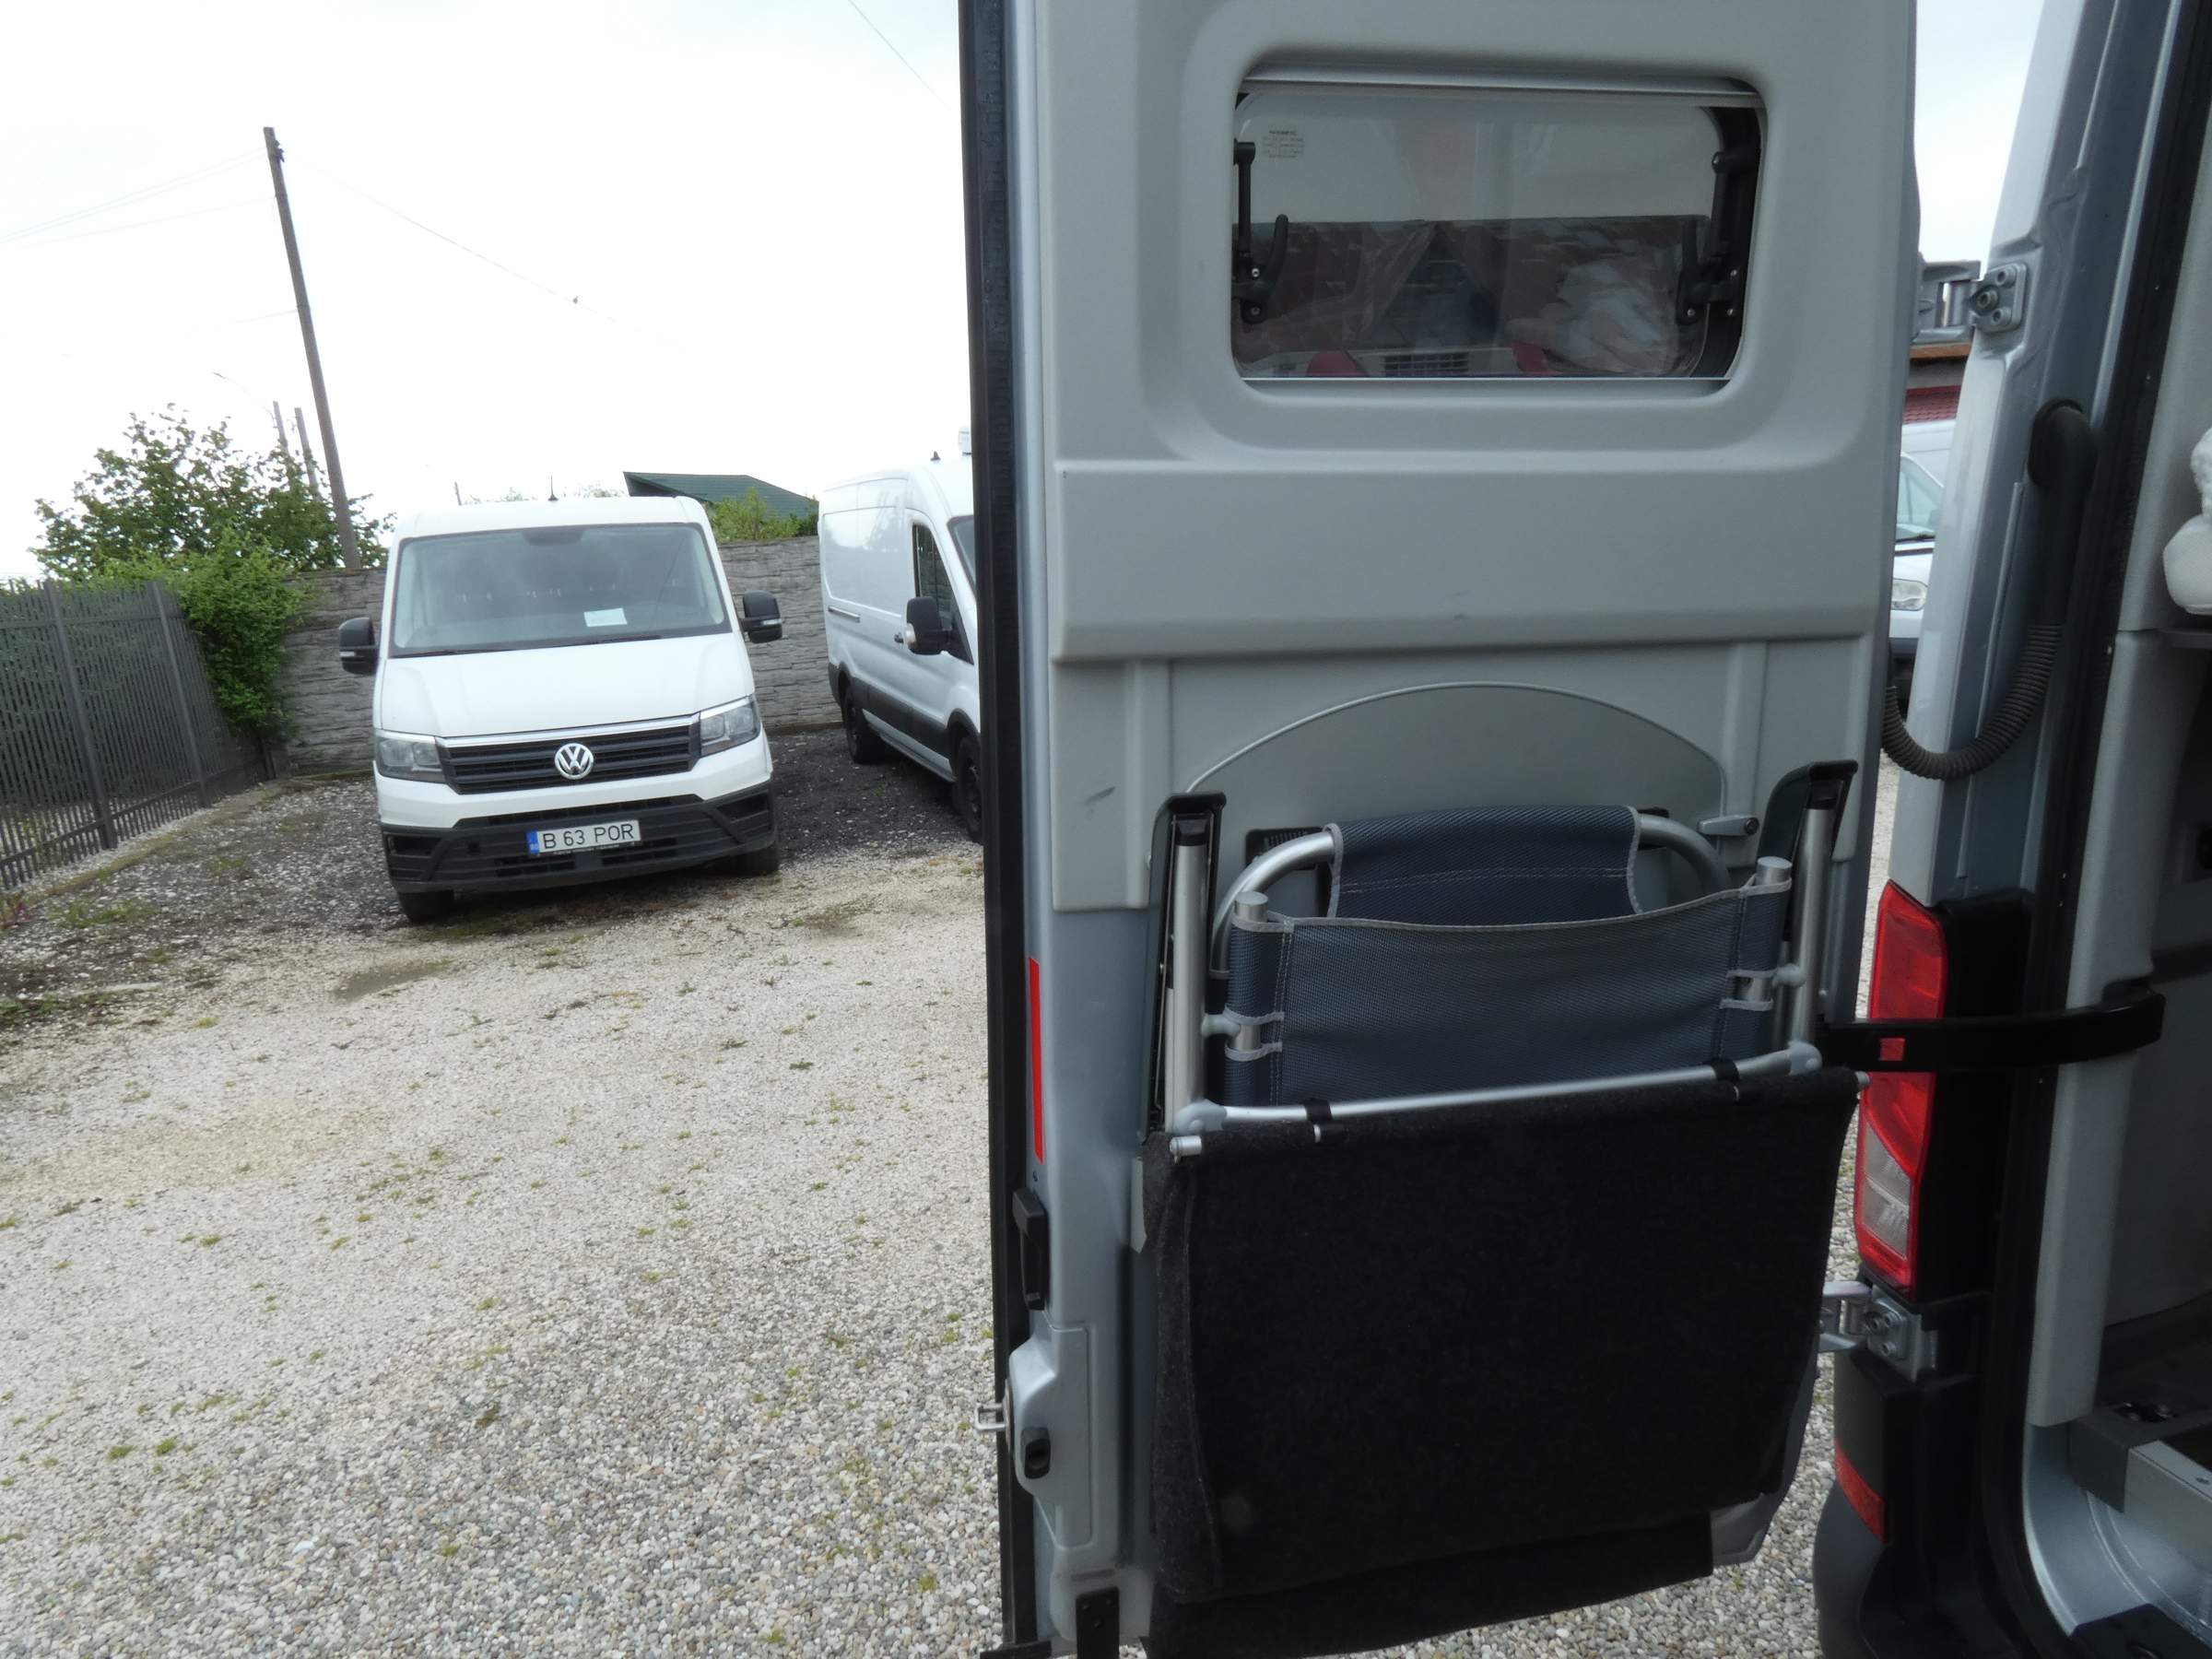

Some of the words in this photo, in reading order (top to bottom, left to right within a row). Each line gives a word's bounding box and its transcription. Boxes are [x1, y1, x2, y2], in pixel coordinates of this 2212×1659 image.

[555, 743, 594, 780] VW
[543, 832, 557, 849] B
[563, 830, 585, 846] 63
[594, 823, 634, 843] POR
